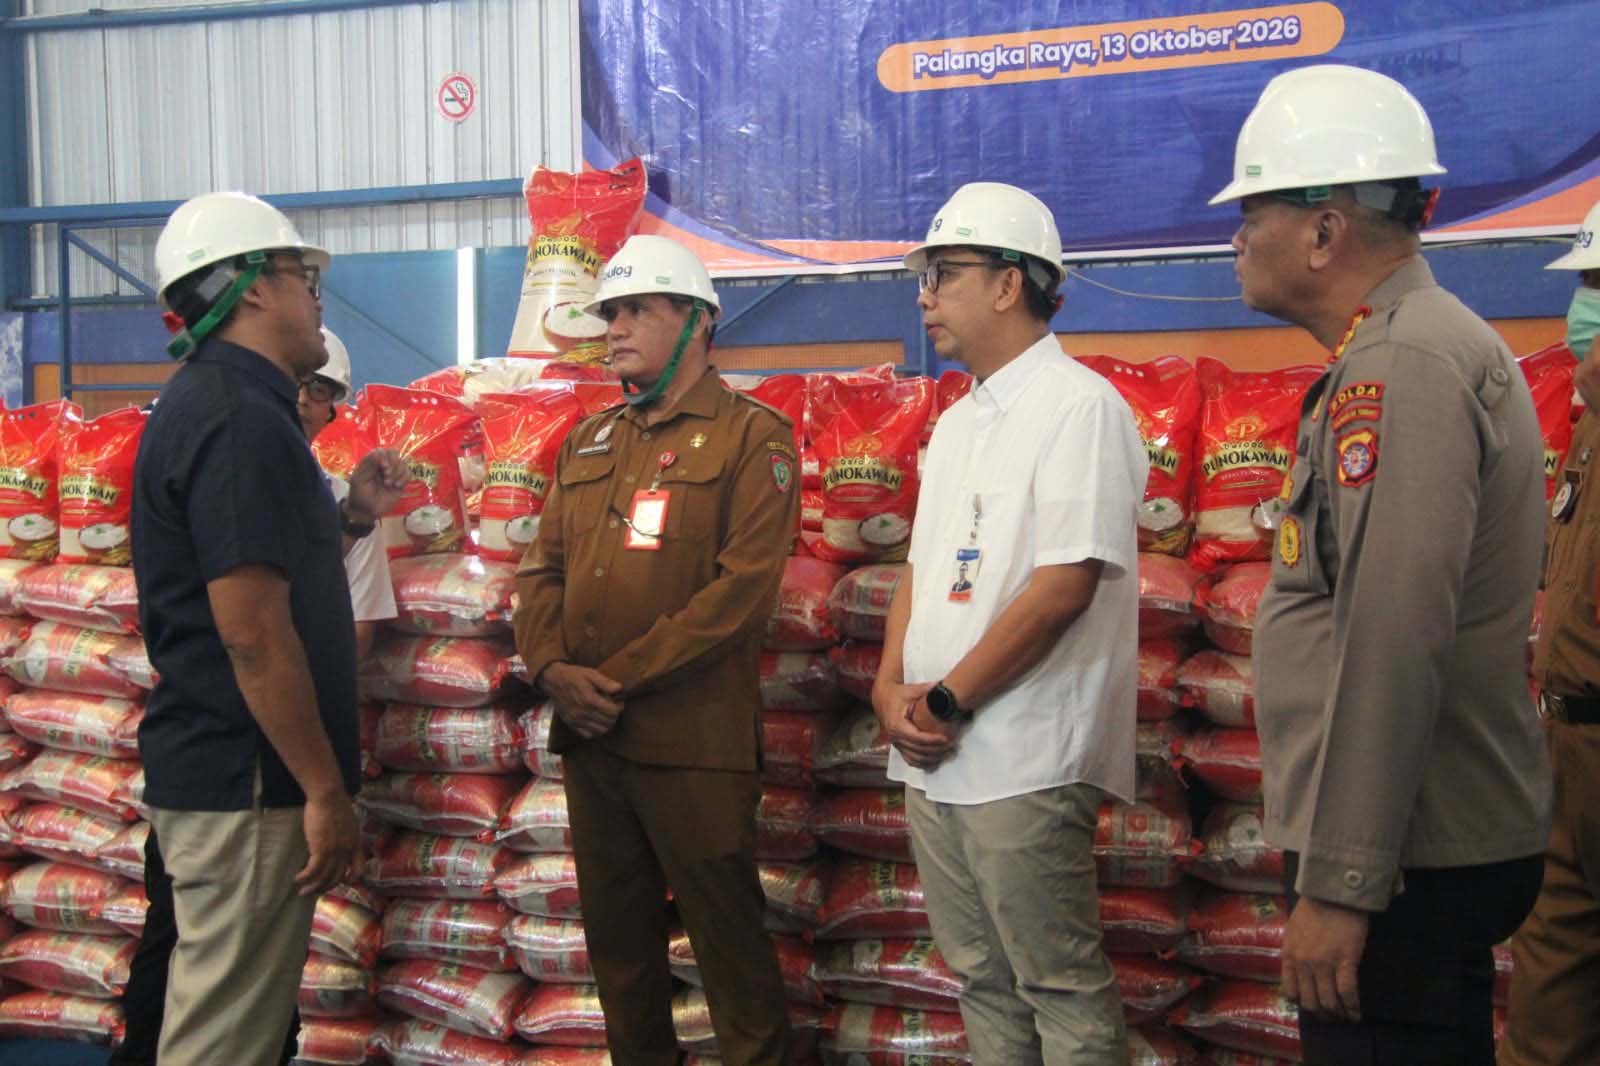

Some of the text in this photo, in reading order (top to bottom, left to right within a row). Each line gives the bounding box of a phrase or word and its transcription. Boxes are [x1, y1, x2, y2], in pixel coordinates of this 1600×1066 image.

[914, 17, 1299, 74] Palangka Raya, 13 Oktober 2026
[1203, 450, 1288, 477] PUNOKAWAN
